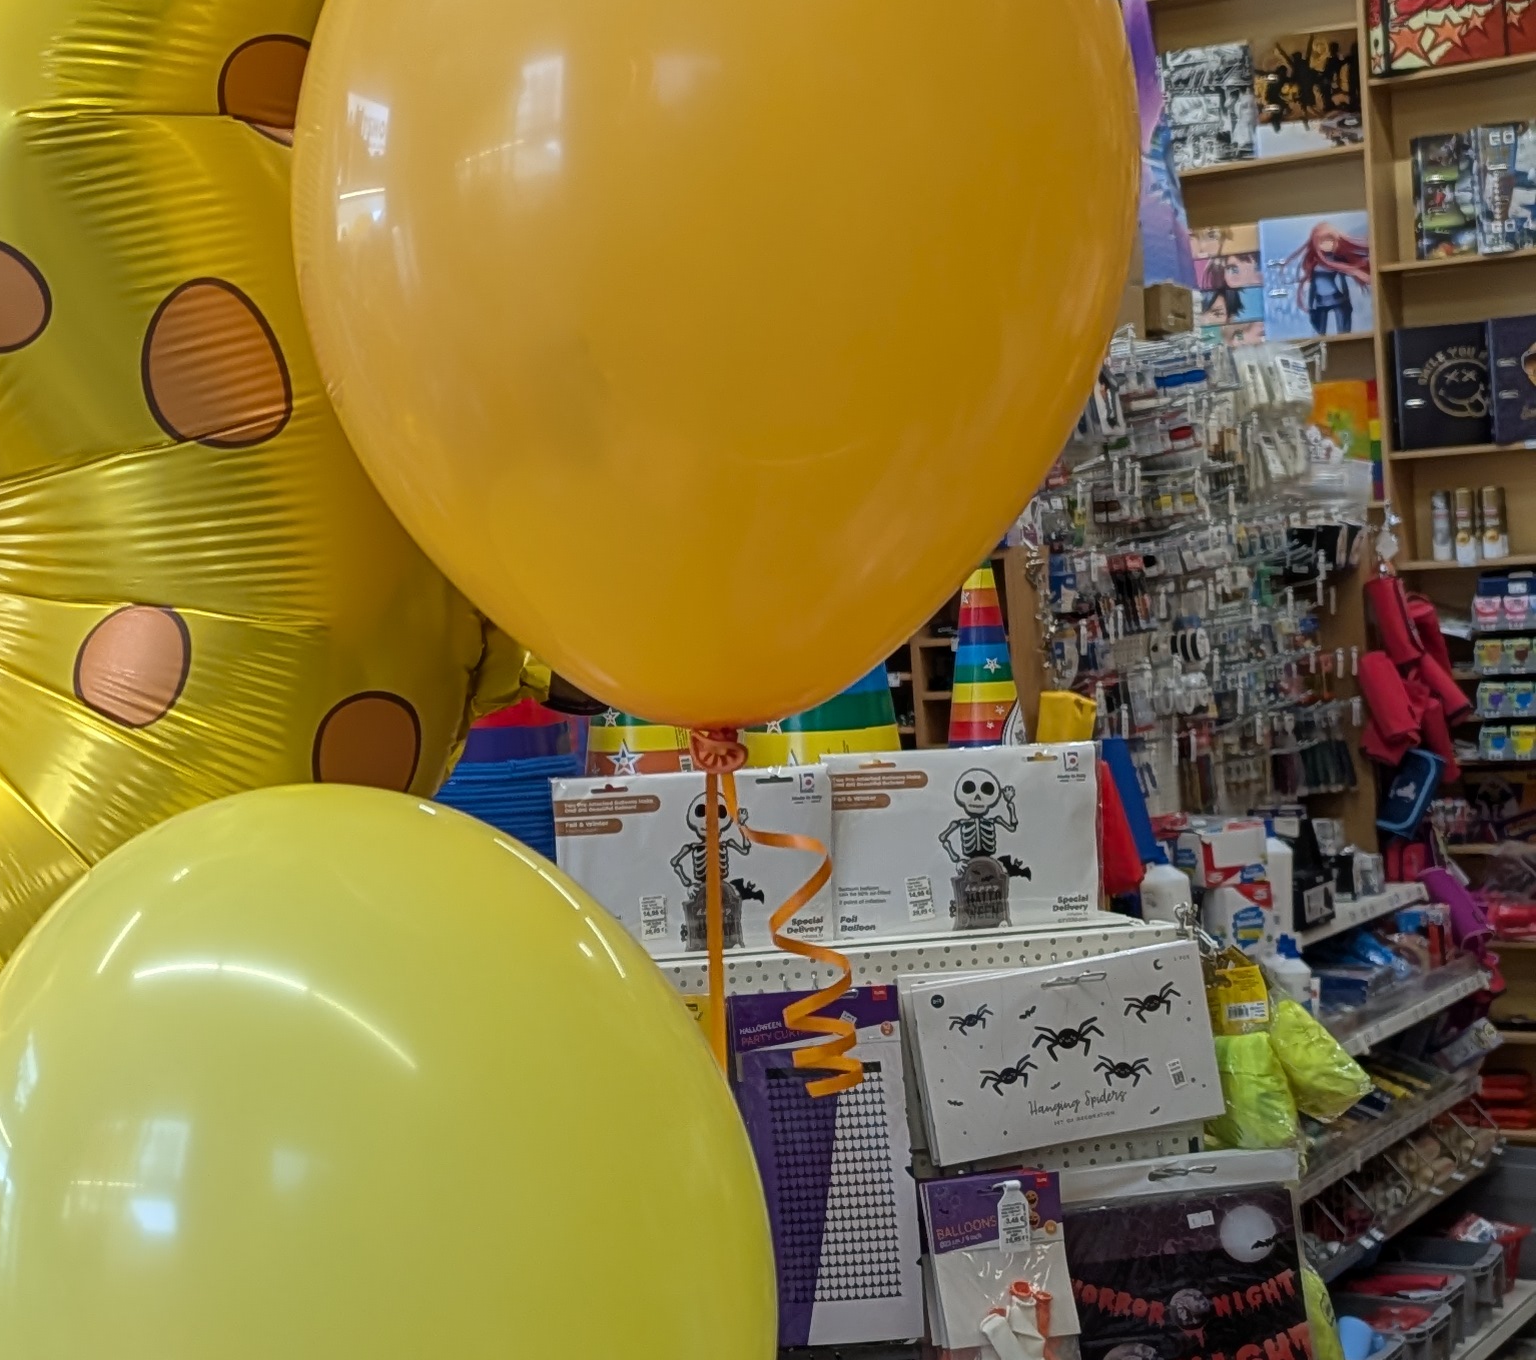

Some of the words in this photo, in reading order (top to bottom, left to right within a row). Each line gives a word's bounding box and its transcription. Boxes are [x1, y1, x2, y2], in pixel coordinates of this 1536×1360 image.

[1057, 894, 1089, 905] Special
[1053, 903, 1089, 913] Delivery
[791, 916, 824, 926] Special
[840, 915, 858, 924] Foil
[786, 925, 824, 934] Delivery
[840, 924, 875, 932] Balloon
[741, 1032, 772, 1046] PARTY
[1028, 1097, 1080, 1118] Hanging
[1084, 1089, 1127, 1107] Spiders
[936, 1215, 997, 1240] BALLOONS
[1212, 1268, 1295, 1318] NIGHT
